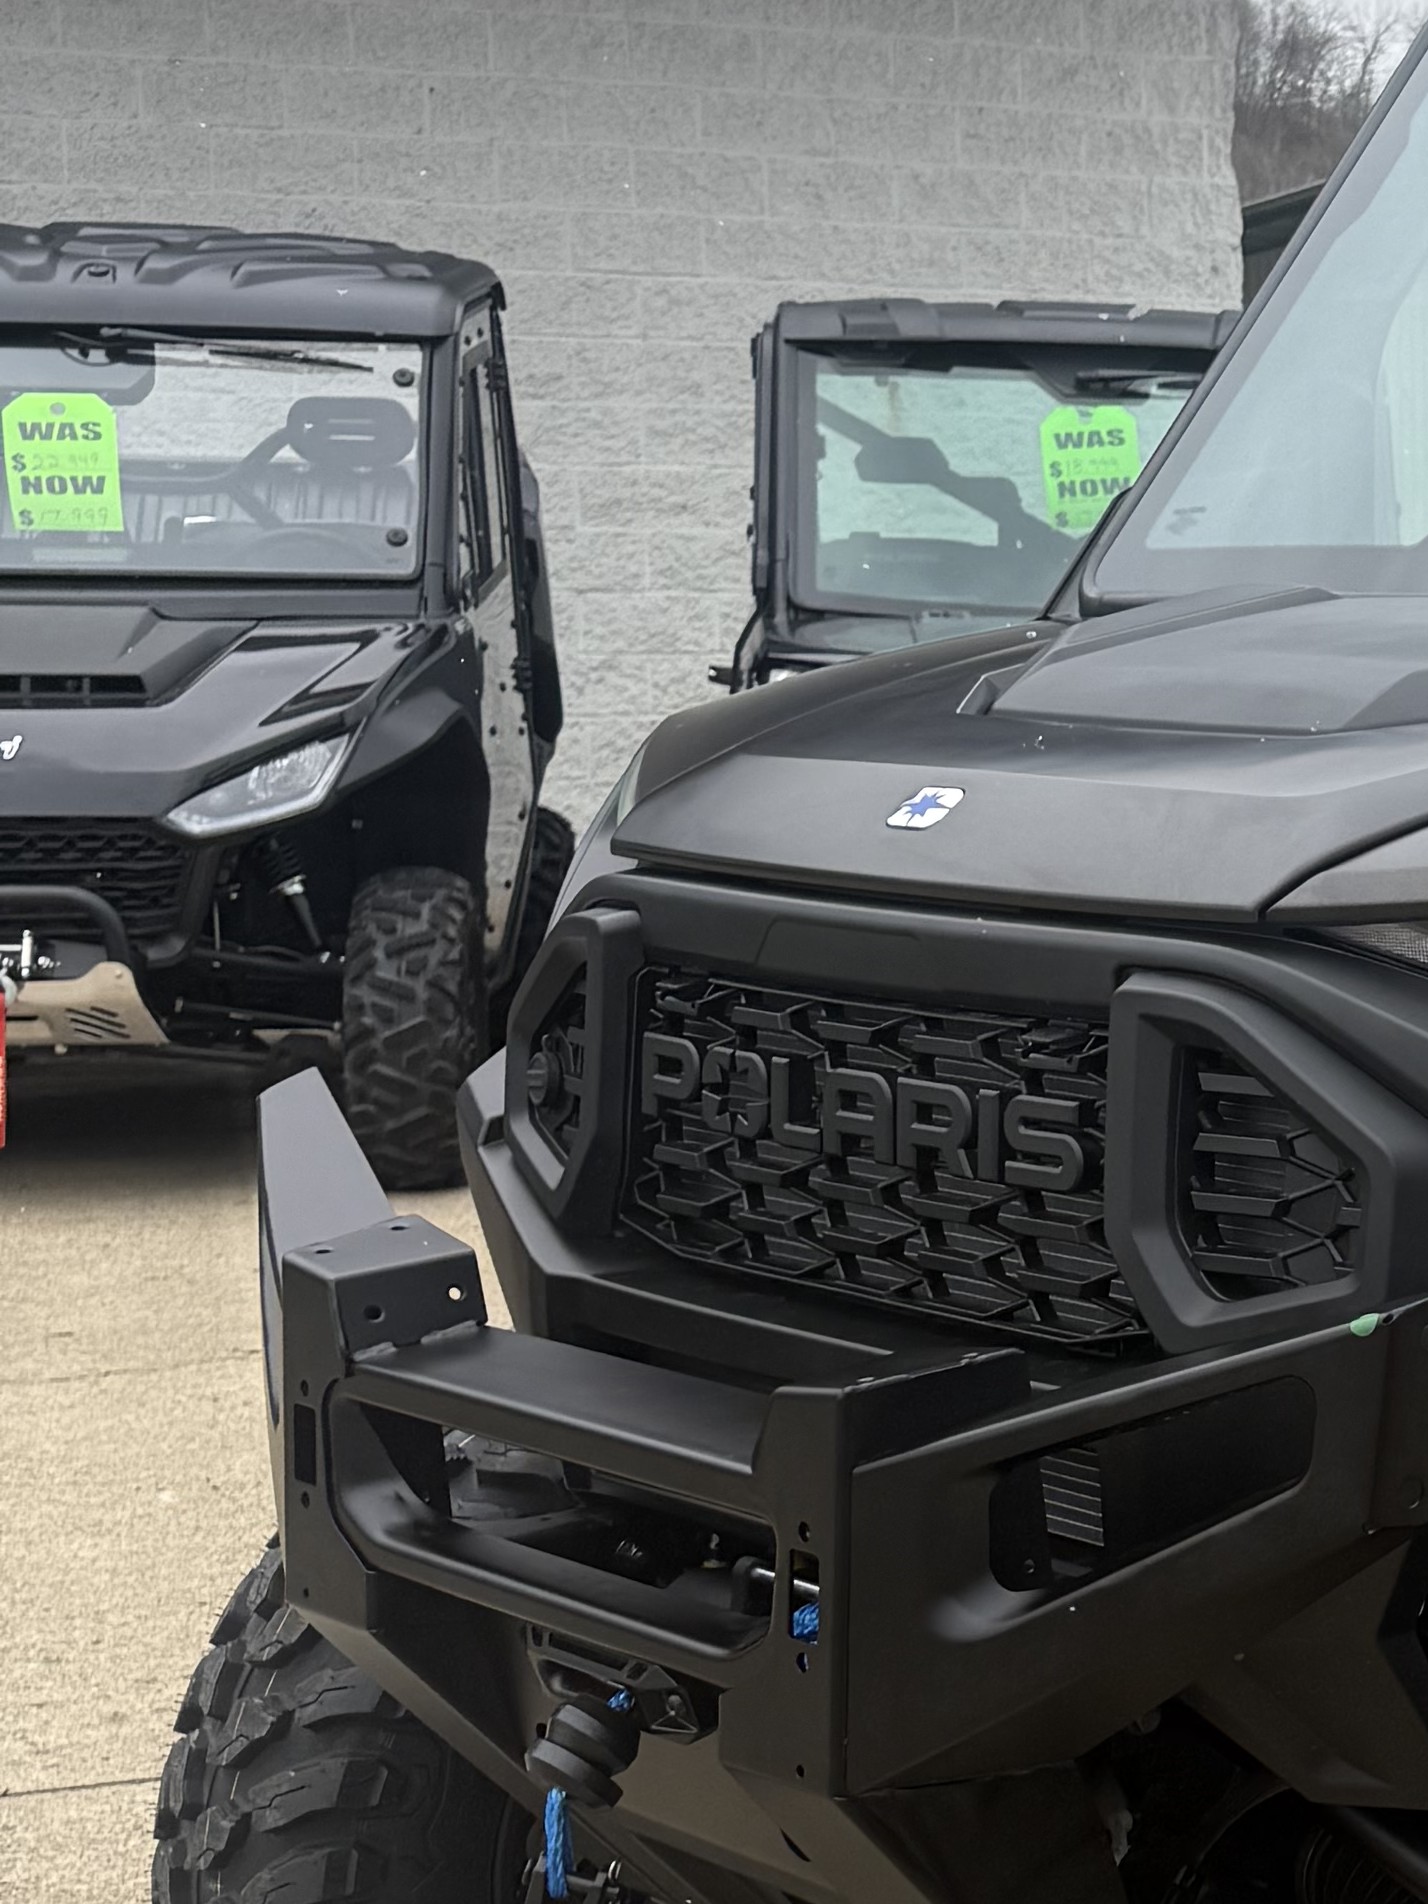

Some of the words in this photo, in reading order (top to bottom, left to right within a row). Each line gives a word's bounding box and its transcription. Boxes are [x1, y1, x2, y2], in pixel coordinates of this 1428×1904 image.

[18, 421, 103, 441] WAS
[1054, 428, 1126, 450] WAS
[20, 475, 106, 495] NOW
[1057, 477, 1131, 499] NOW
[640, 1030, 1085, 1193] POLARIS
